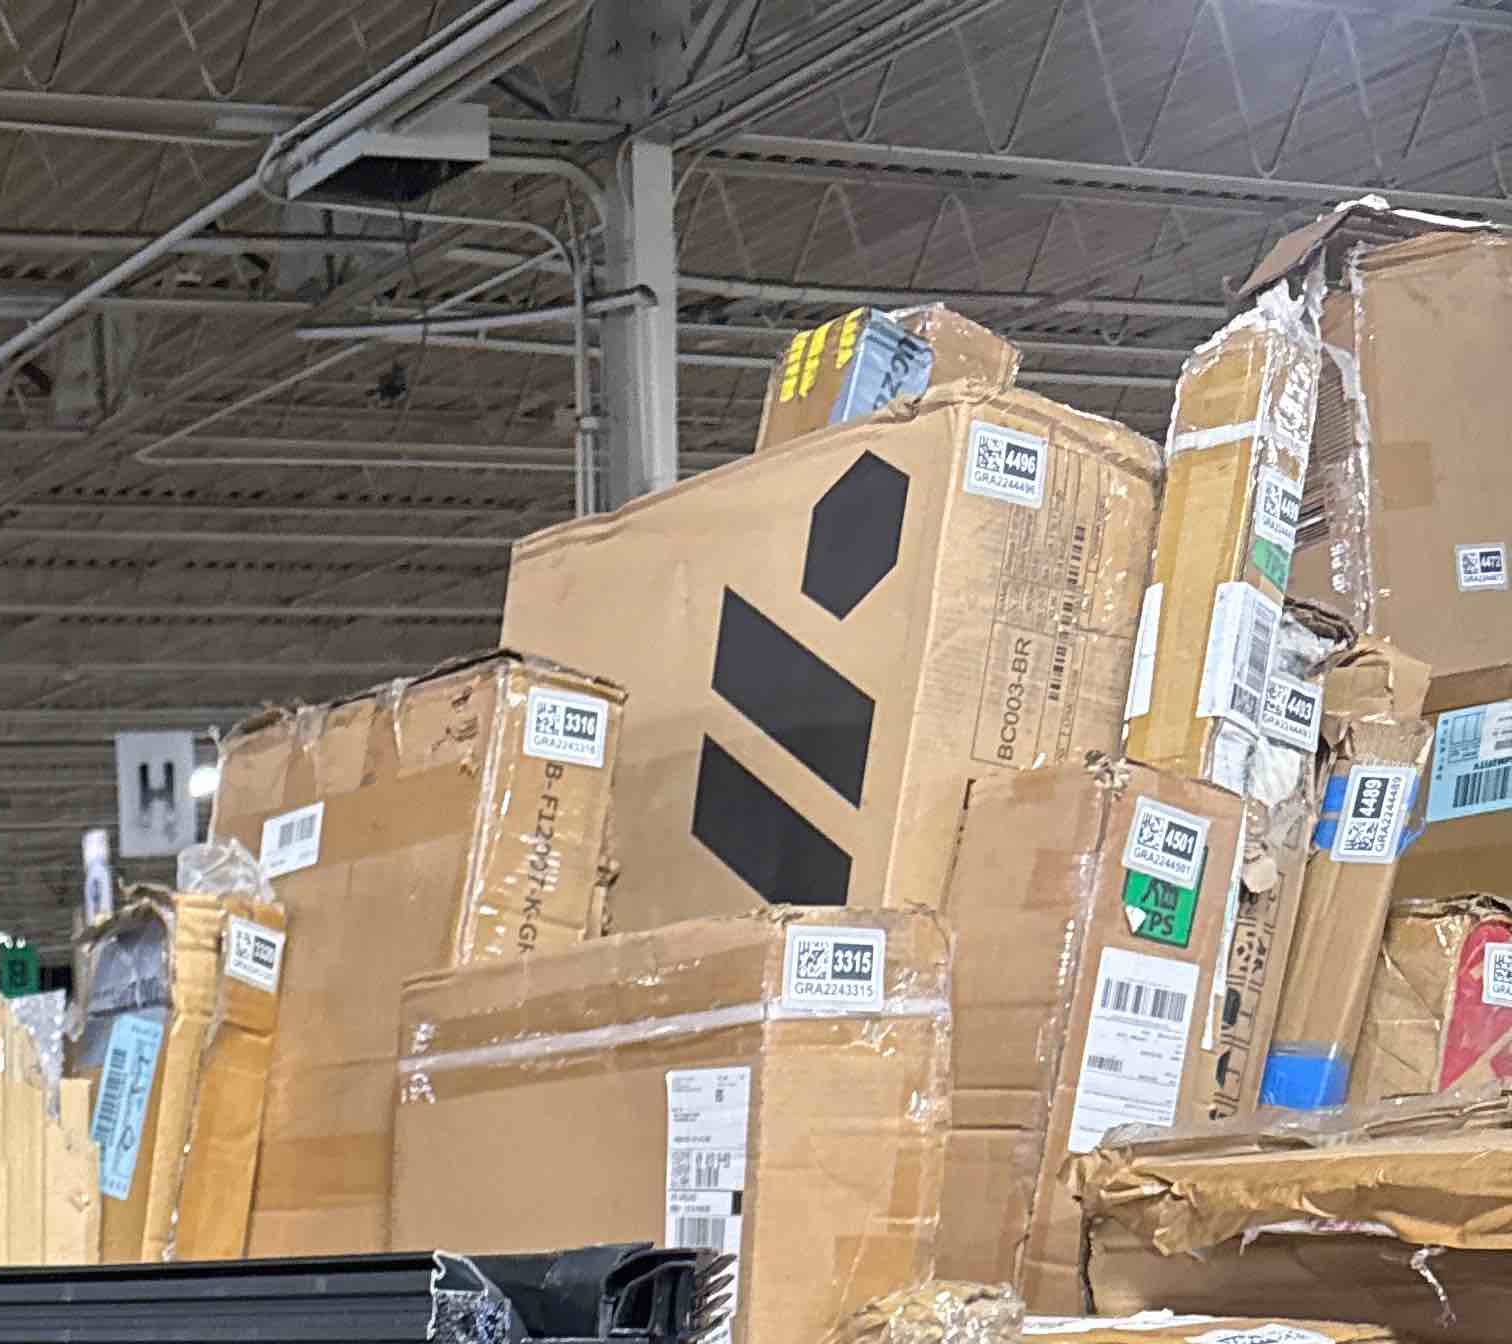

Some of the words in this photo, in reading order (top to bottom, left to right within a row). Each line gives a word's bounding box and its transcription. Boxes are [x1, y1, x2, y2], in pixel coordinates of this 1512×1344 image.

[1006, 448, 1036, 476] 4496
[997, 637, 1032, 761] BC003-BR
[139, 761, 174, 812] H
[1357, 778, 1384, 819] 4489
[1165, 826, 1197, 856] 4501
[833, 949, 873, 974] 3315
[794, 982, 874, 998] GRA2243315
